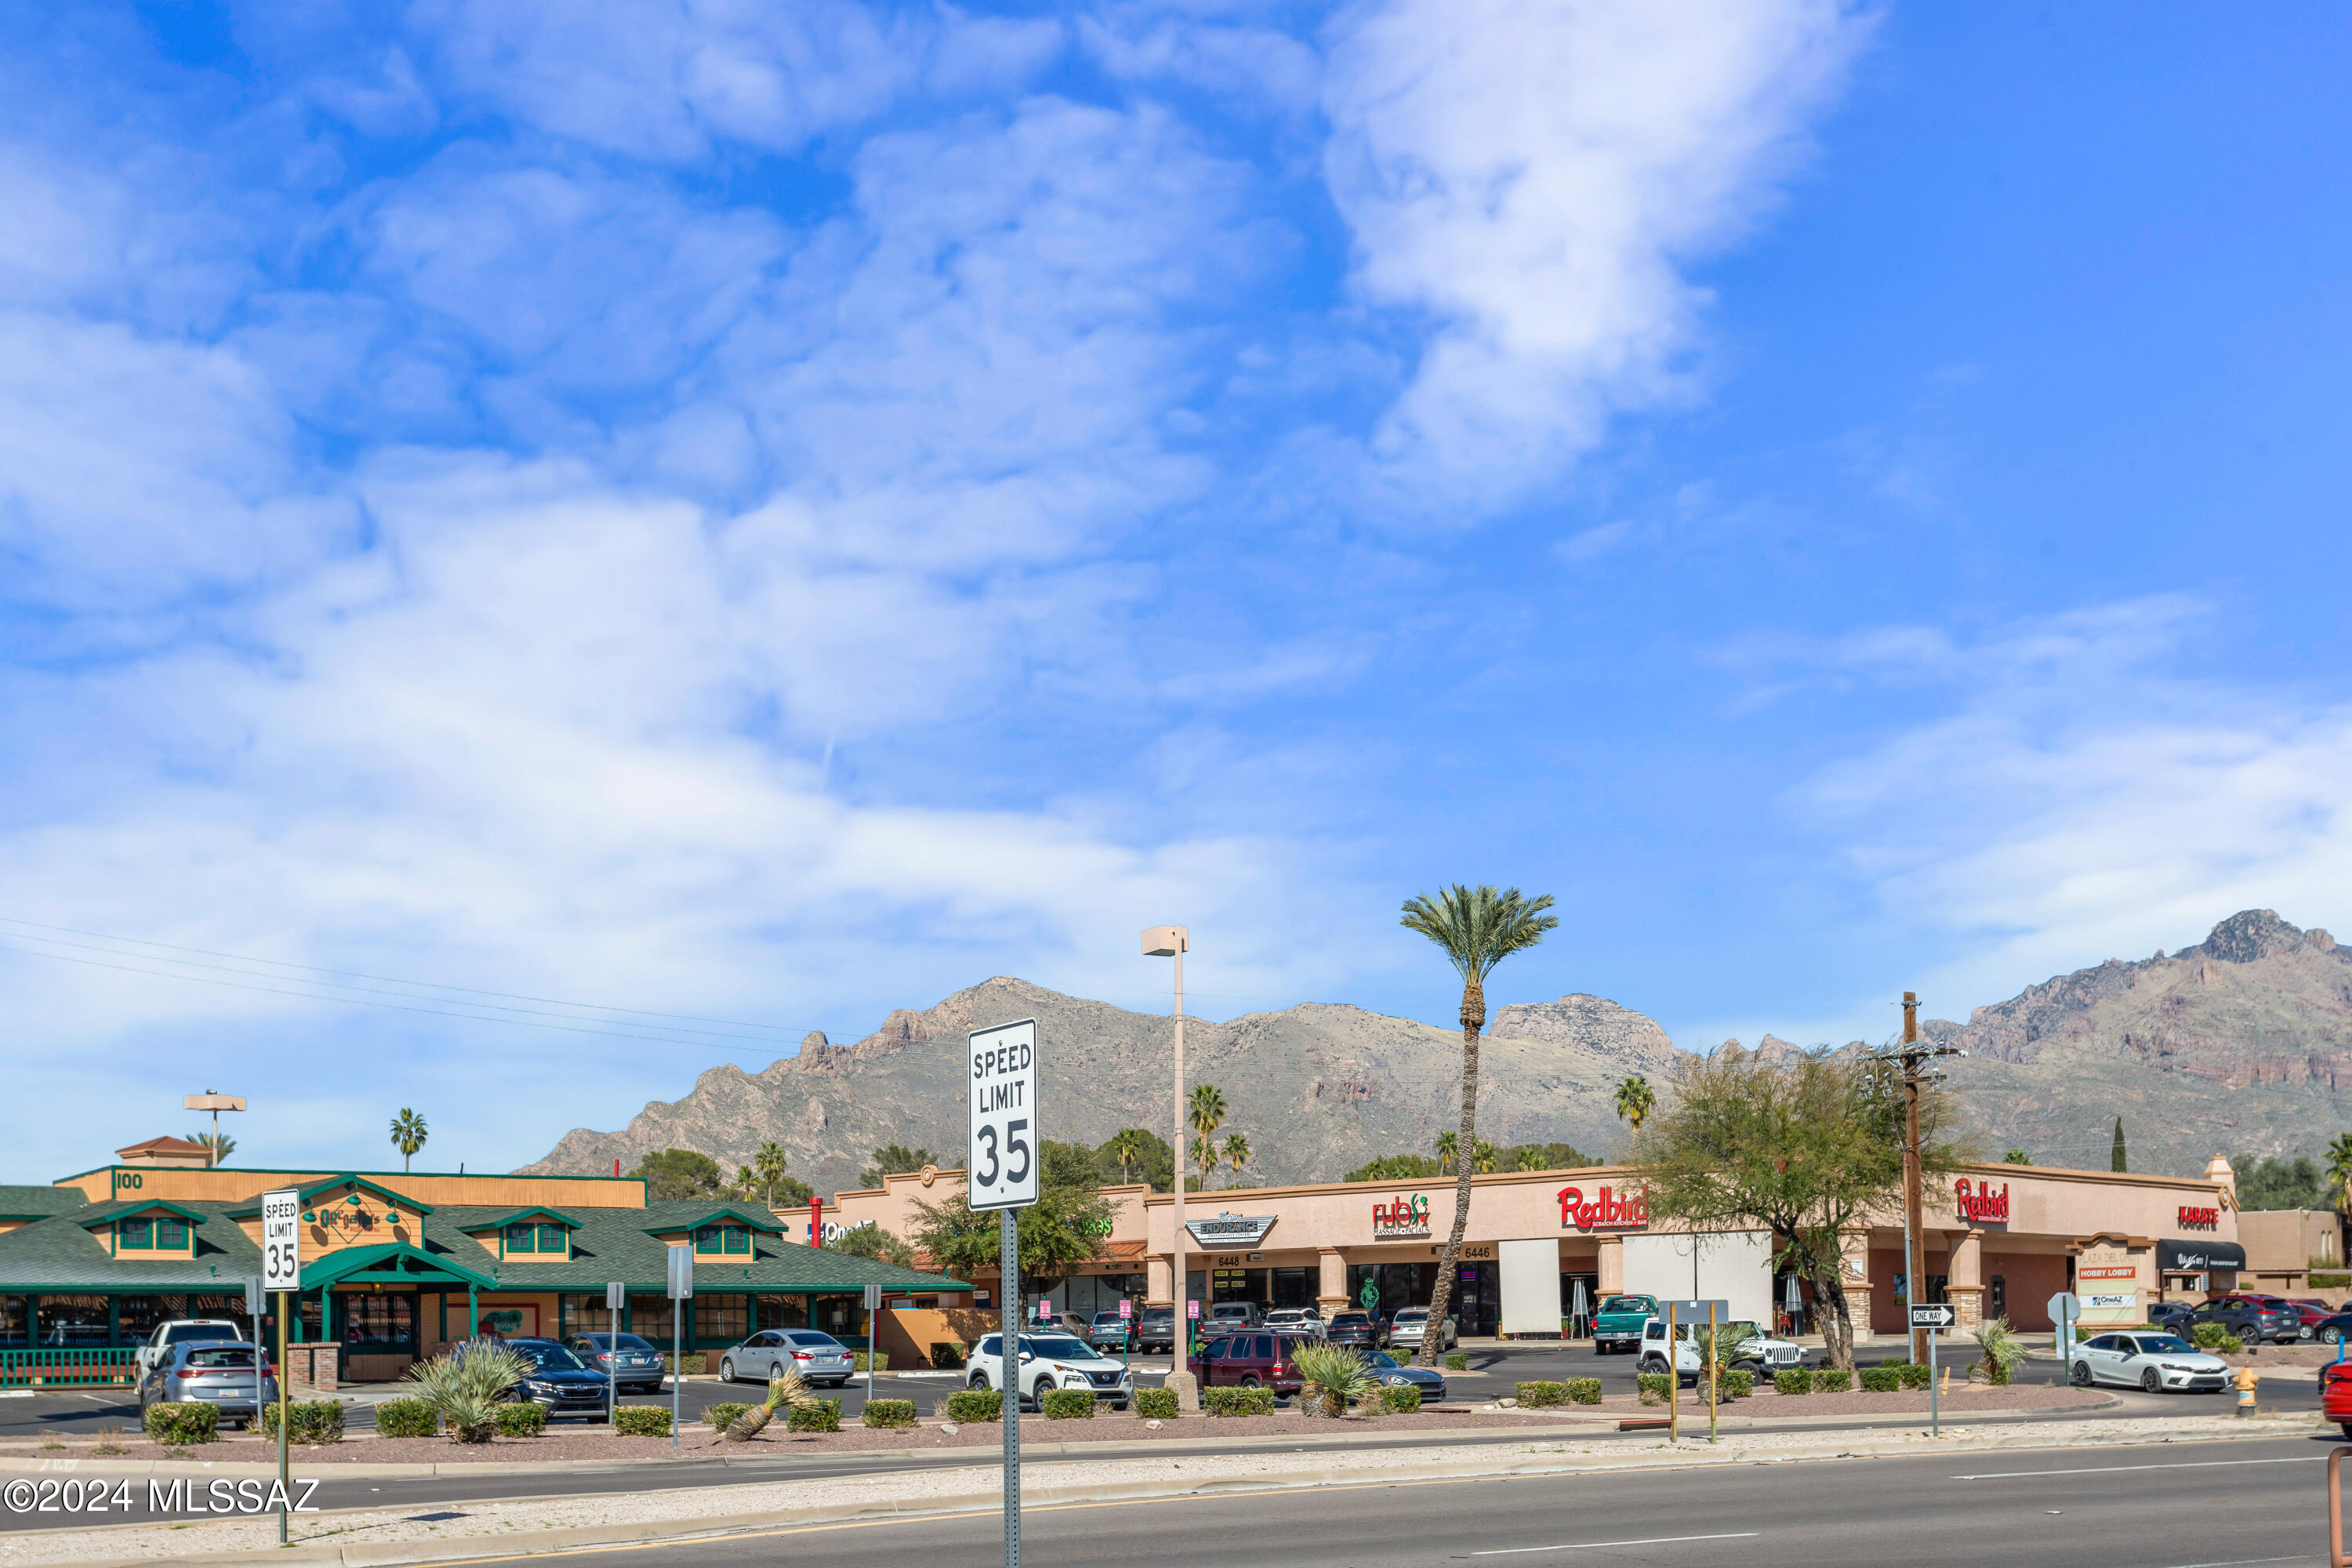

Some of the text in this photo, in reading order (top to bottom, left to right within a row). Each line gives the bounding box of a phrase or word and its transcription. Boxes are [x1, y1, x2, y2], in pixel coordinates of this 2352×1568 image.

[974, 1044, 1031, 1079] SPEED
[979, 1080, 1025, 1113] LIMIT
[976, 1119, 1030, 1187] 35
[118, 1174, 143, 1189] 100
[1557, 1184, 1648, 1228] Redbird
[1957, 1178, 2009, 1221] Redbird
[266, 1202, 296, 1219] SPEED
[1218, 1210, 1242, 1222] Tucson
[2179, 1206, 2219, 1224] KARATE
[269, 1222, 293, 1238] LIMIT
[1201, 1221, 1257, 1233] ENDURANCE
[1374, 1226, 1429, 1236] MASSAGE FACIALS
[1465, 1247, 1490, 1258] 6446
[267, 1243, 296, 1279] 35
[1218, 1257, 1240, 1267] 6448
[1915, 1311, 1942, 1320] ONE WAY
